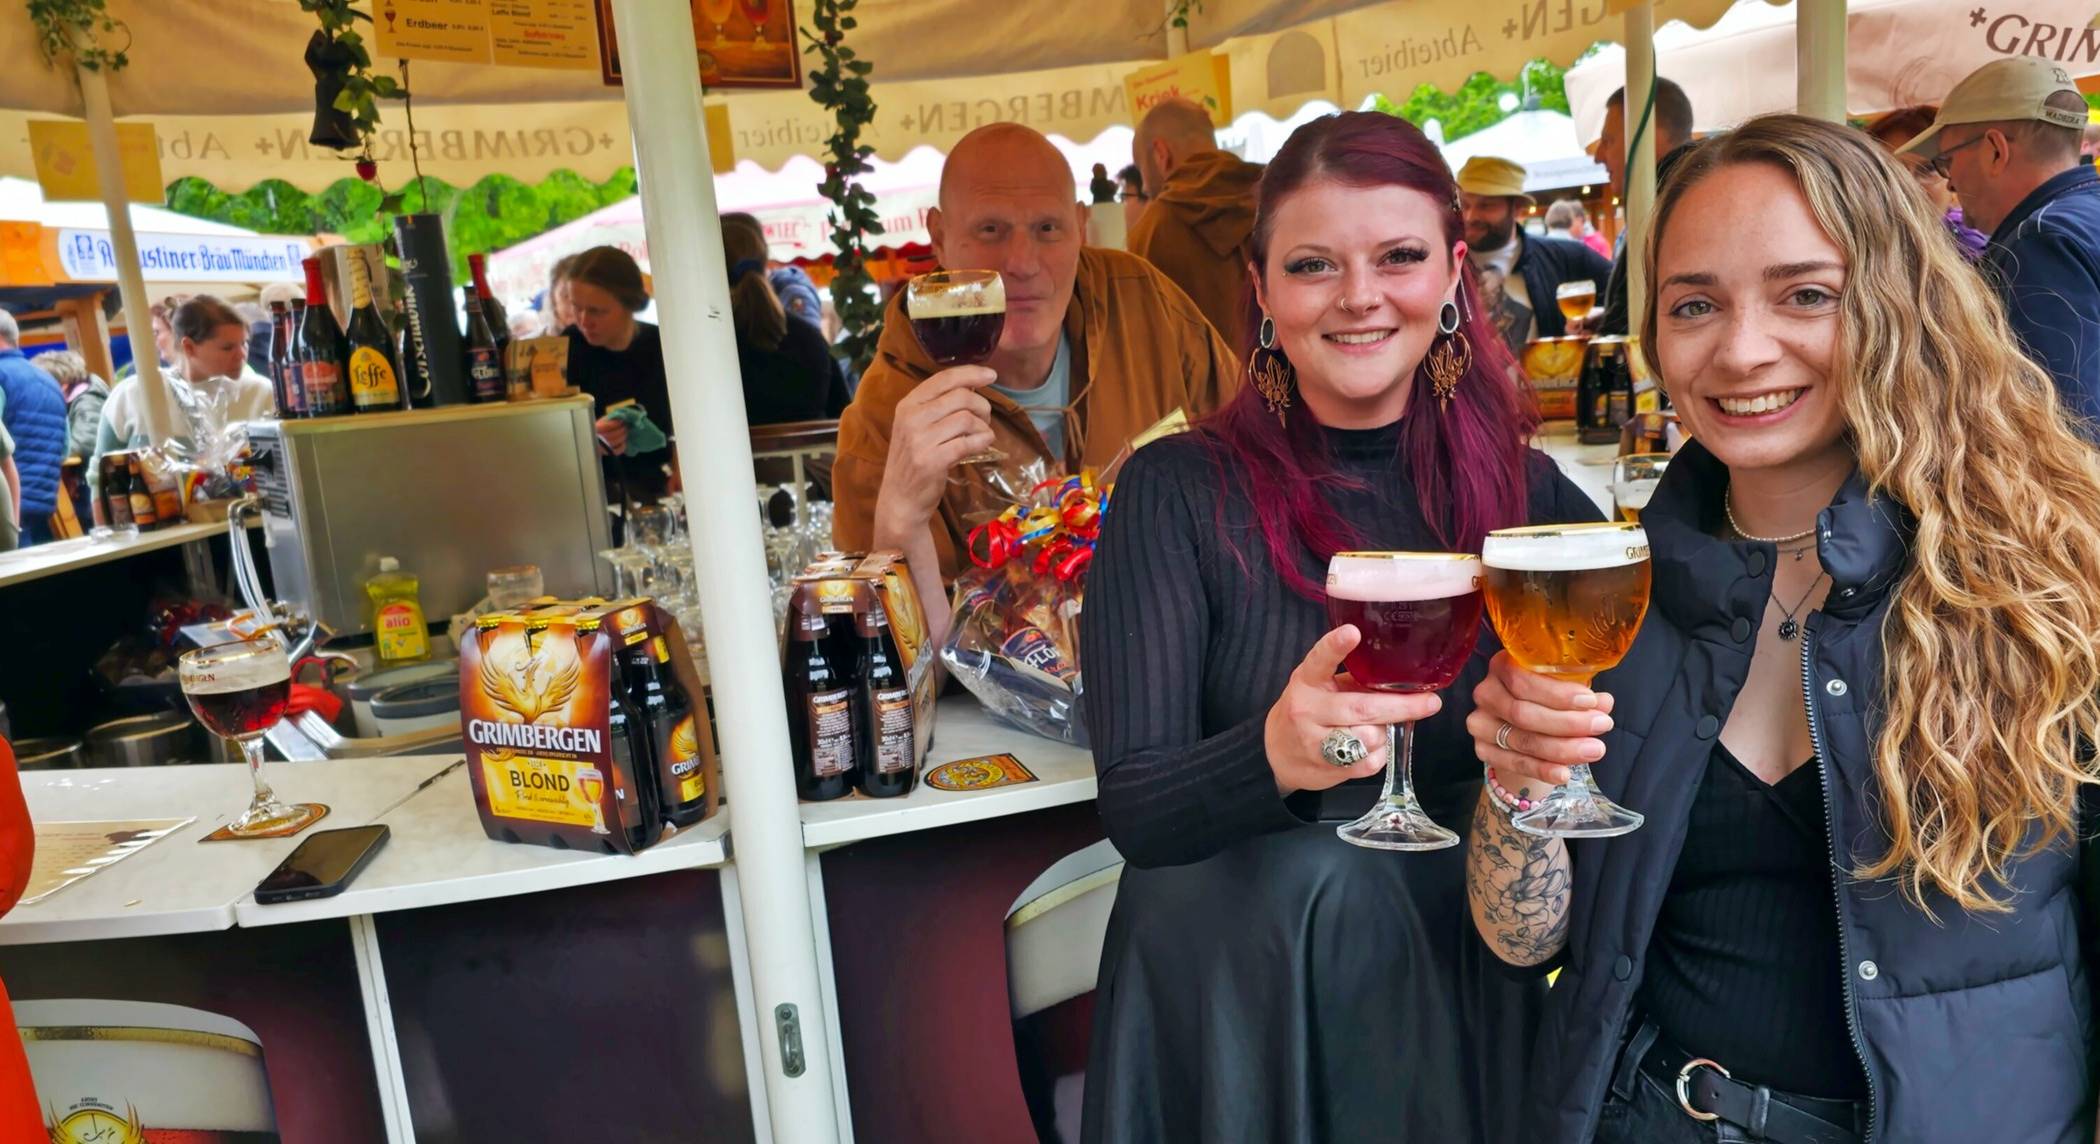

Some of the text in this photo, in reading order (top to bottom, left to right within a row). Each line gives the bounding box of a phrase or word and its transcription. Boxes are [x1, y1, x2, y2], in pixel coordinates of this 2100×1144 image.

[1986, 13, 2100, 63] GRIM
[97, 239, 196, 270] Austiner
[354, 362, 387, 388] Leffe
[386, 616, 410, 628] alio
[469, 719, 601, 753] GRIMBERGEN
[509, 770, 570, 792] BLOND
